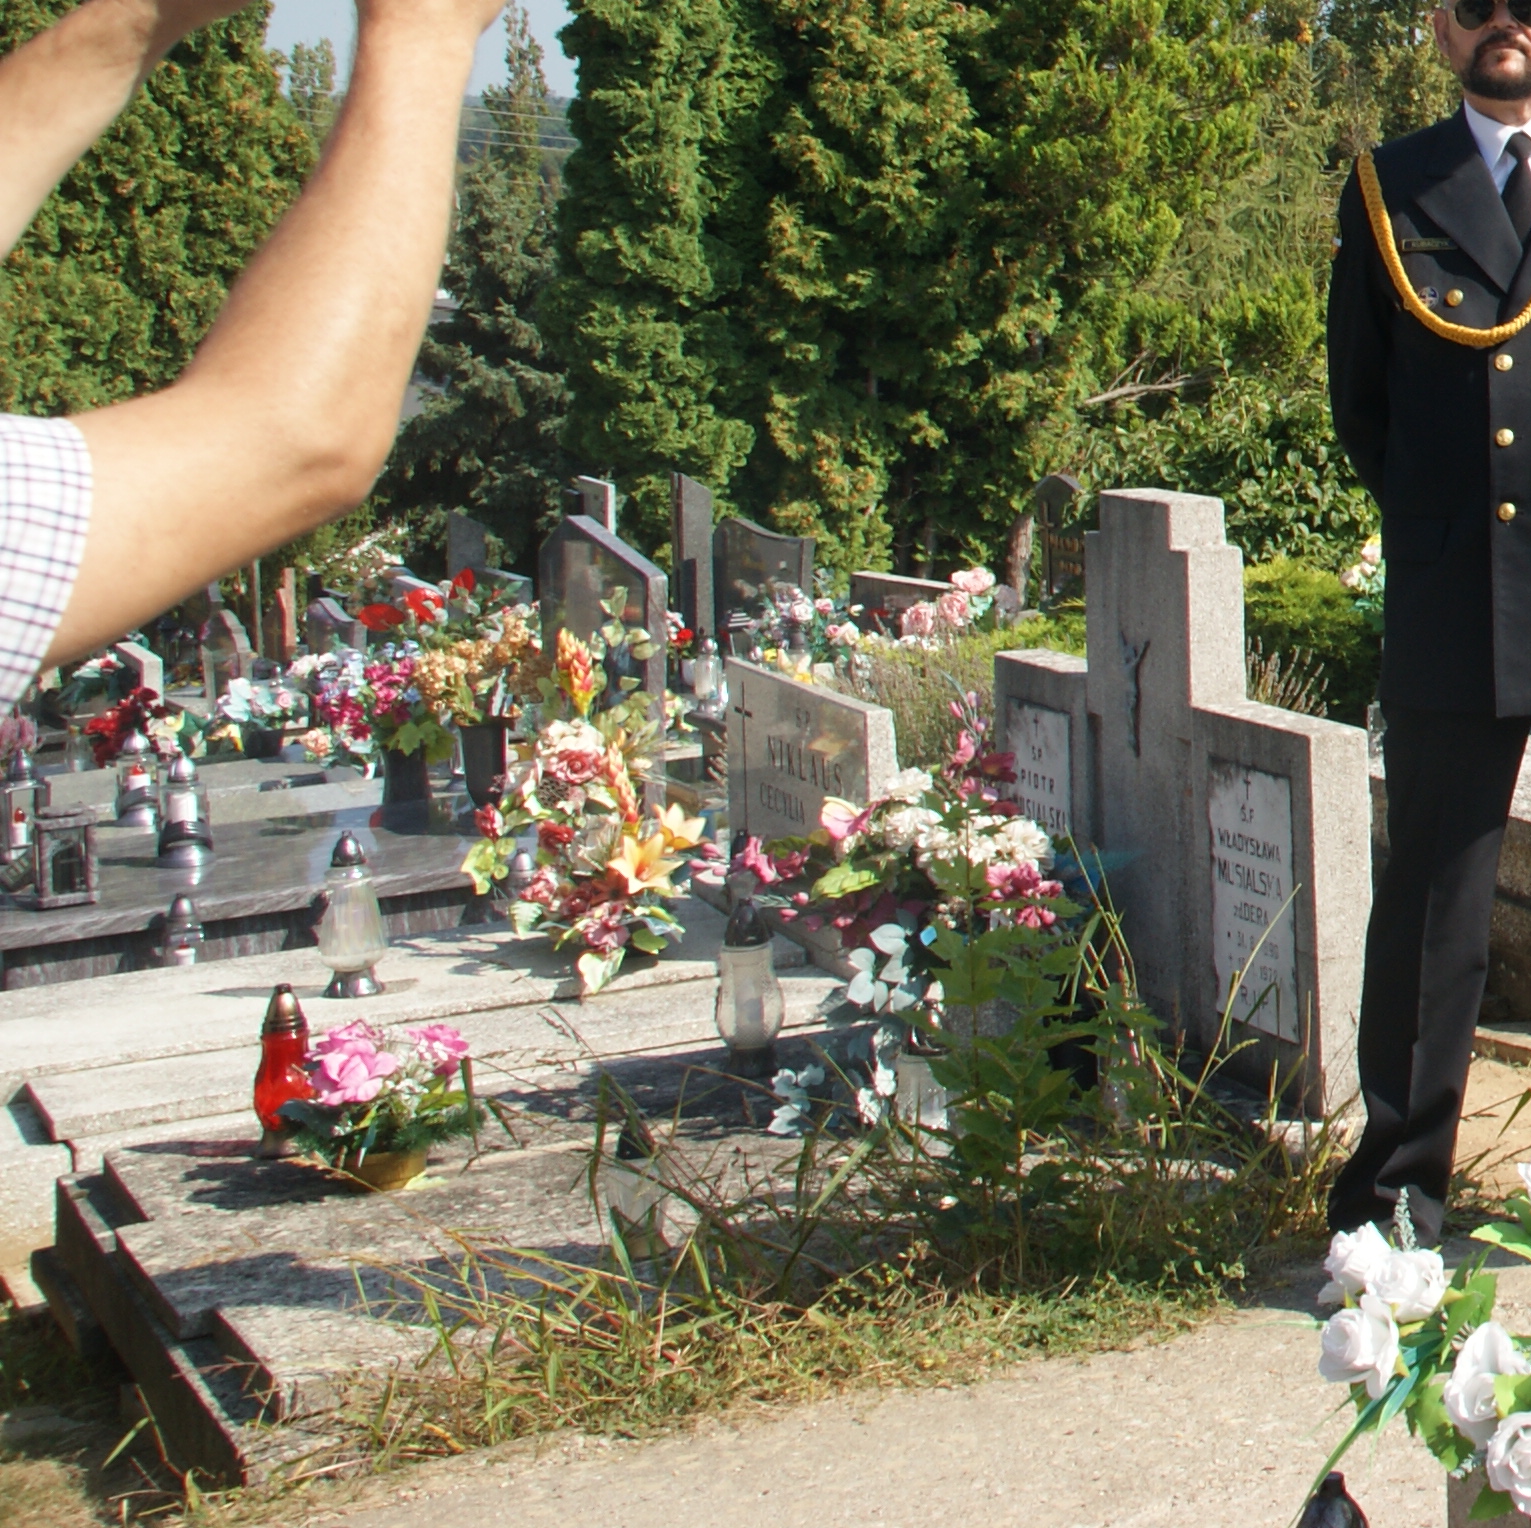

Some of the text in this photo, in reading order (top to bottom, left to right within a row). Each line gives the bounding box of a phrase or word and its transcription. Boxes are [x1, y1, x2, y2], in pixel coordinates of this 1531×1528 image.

[767, 734, 843, 796] NIKLAUS
[1020, 769, 1055, 794] PIOTR
[760, 781, 806, 825] CECYLIA
